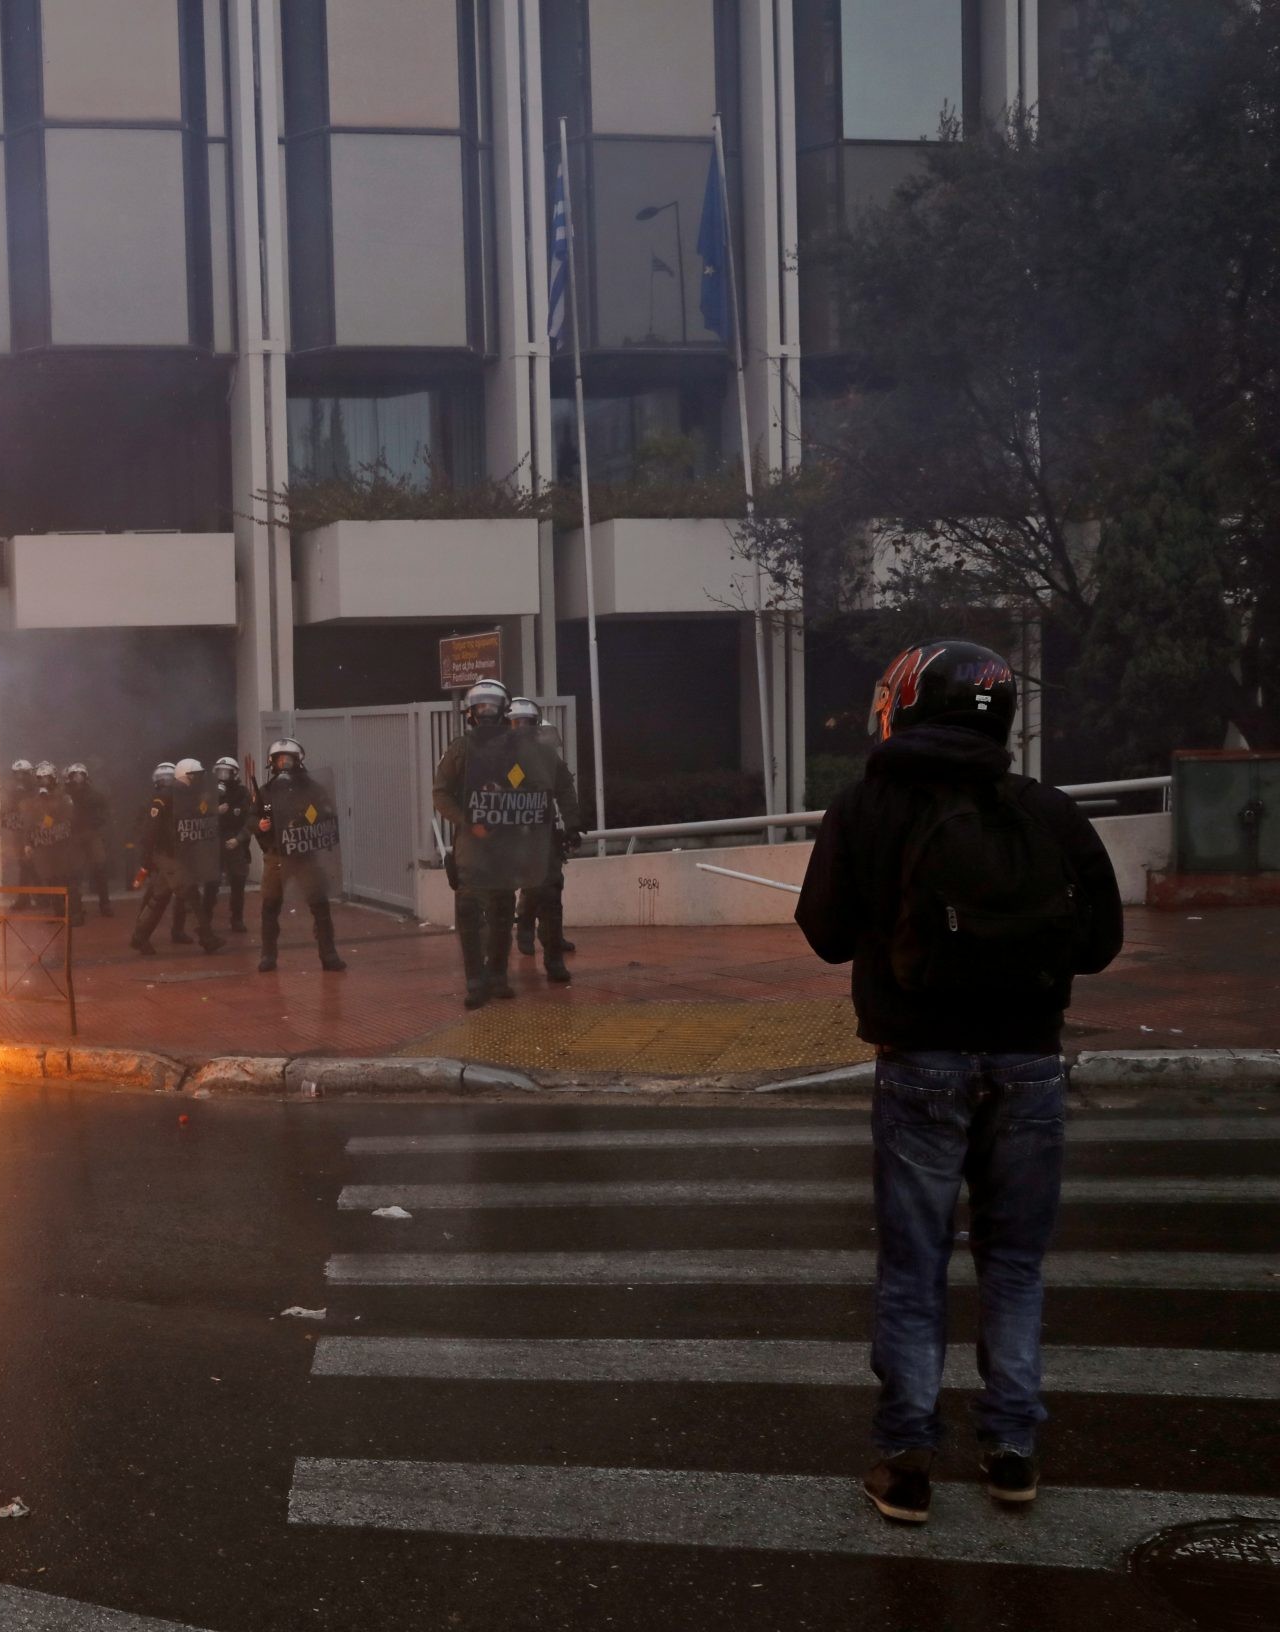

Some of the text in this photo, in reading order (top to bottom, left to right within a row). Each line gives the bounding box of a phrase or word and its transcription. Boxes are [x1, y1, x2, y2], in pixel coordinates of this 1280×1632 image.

[468, 790, 548, 810] ΑΣΤΥΝΟΜΙΑ
[472, 809, 544, 825] POLICE
[285, 832, 337, 855] POLICE
